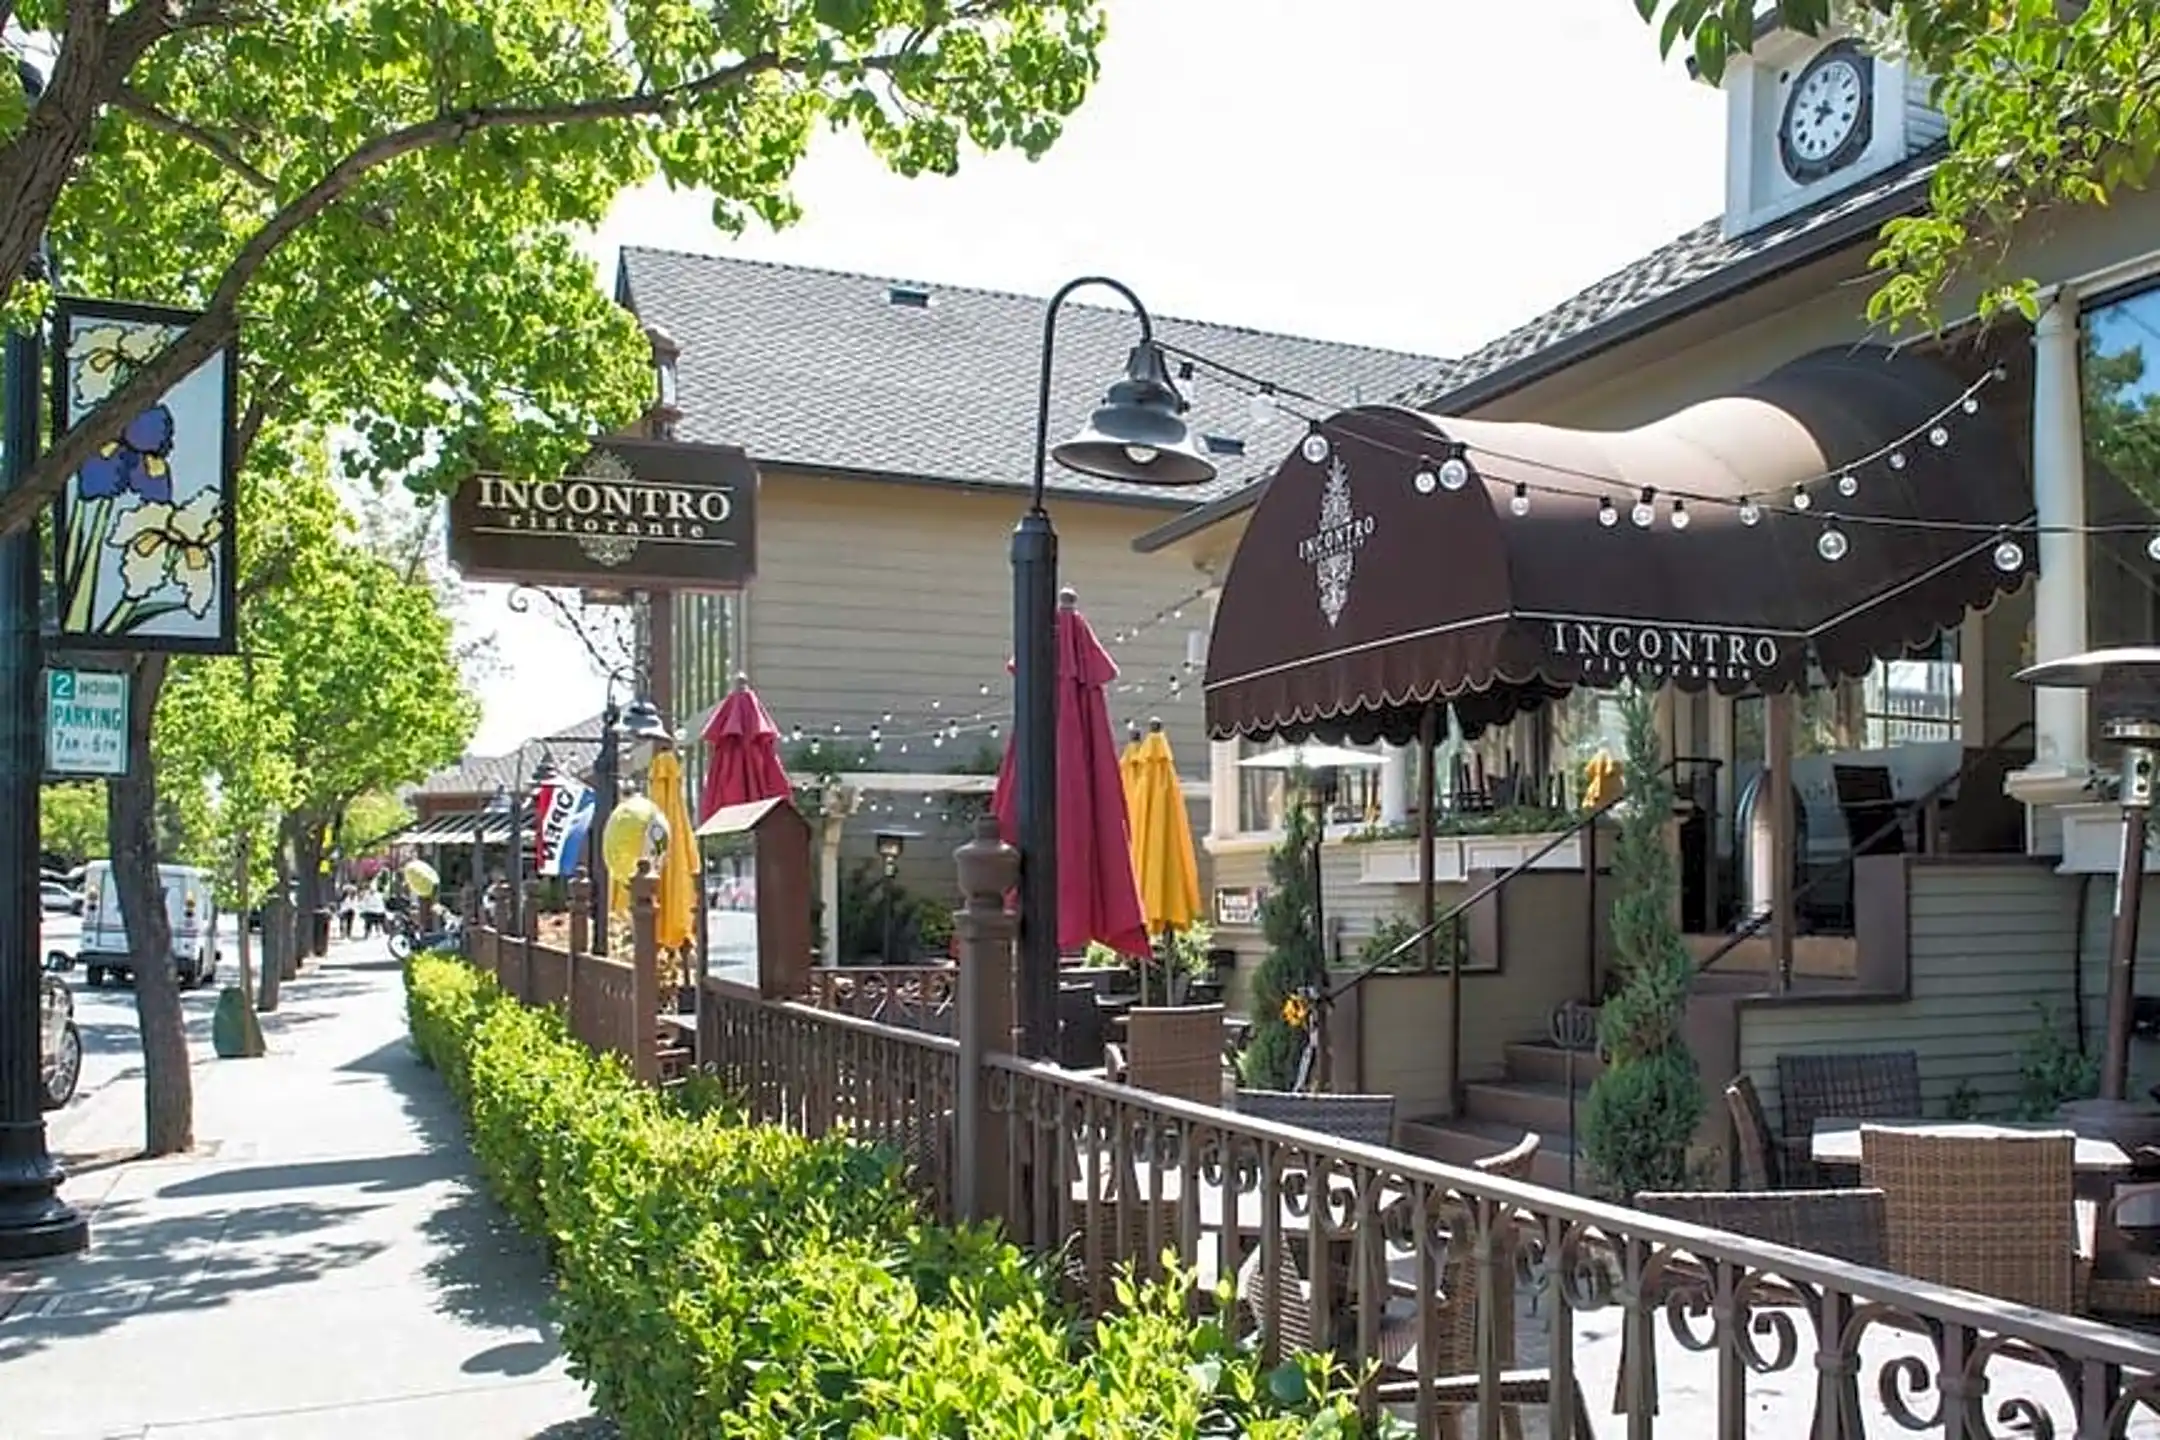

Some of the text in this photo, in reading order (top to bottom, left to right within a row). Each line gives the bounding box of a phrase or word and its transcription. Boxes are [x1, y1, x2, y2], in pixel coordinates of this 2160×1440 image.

[476, 477, 732, 522] INCONTRO
[509, 511, 704, 538] ristorante
[1298, 516, 1374, 559] INCONTRO
[1552, 622, 1778, 666] INCONTRO
[55, 674, 72, 696] 2
[53, 705, 121, 731] PARKING
